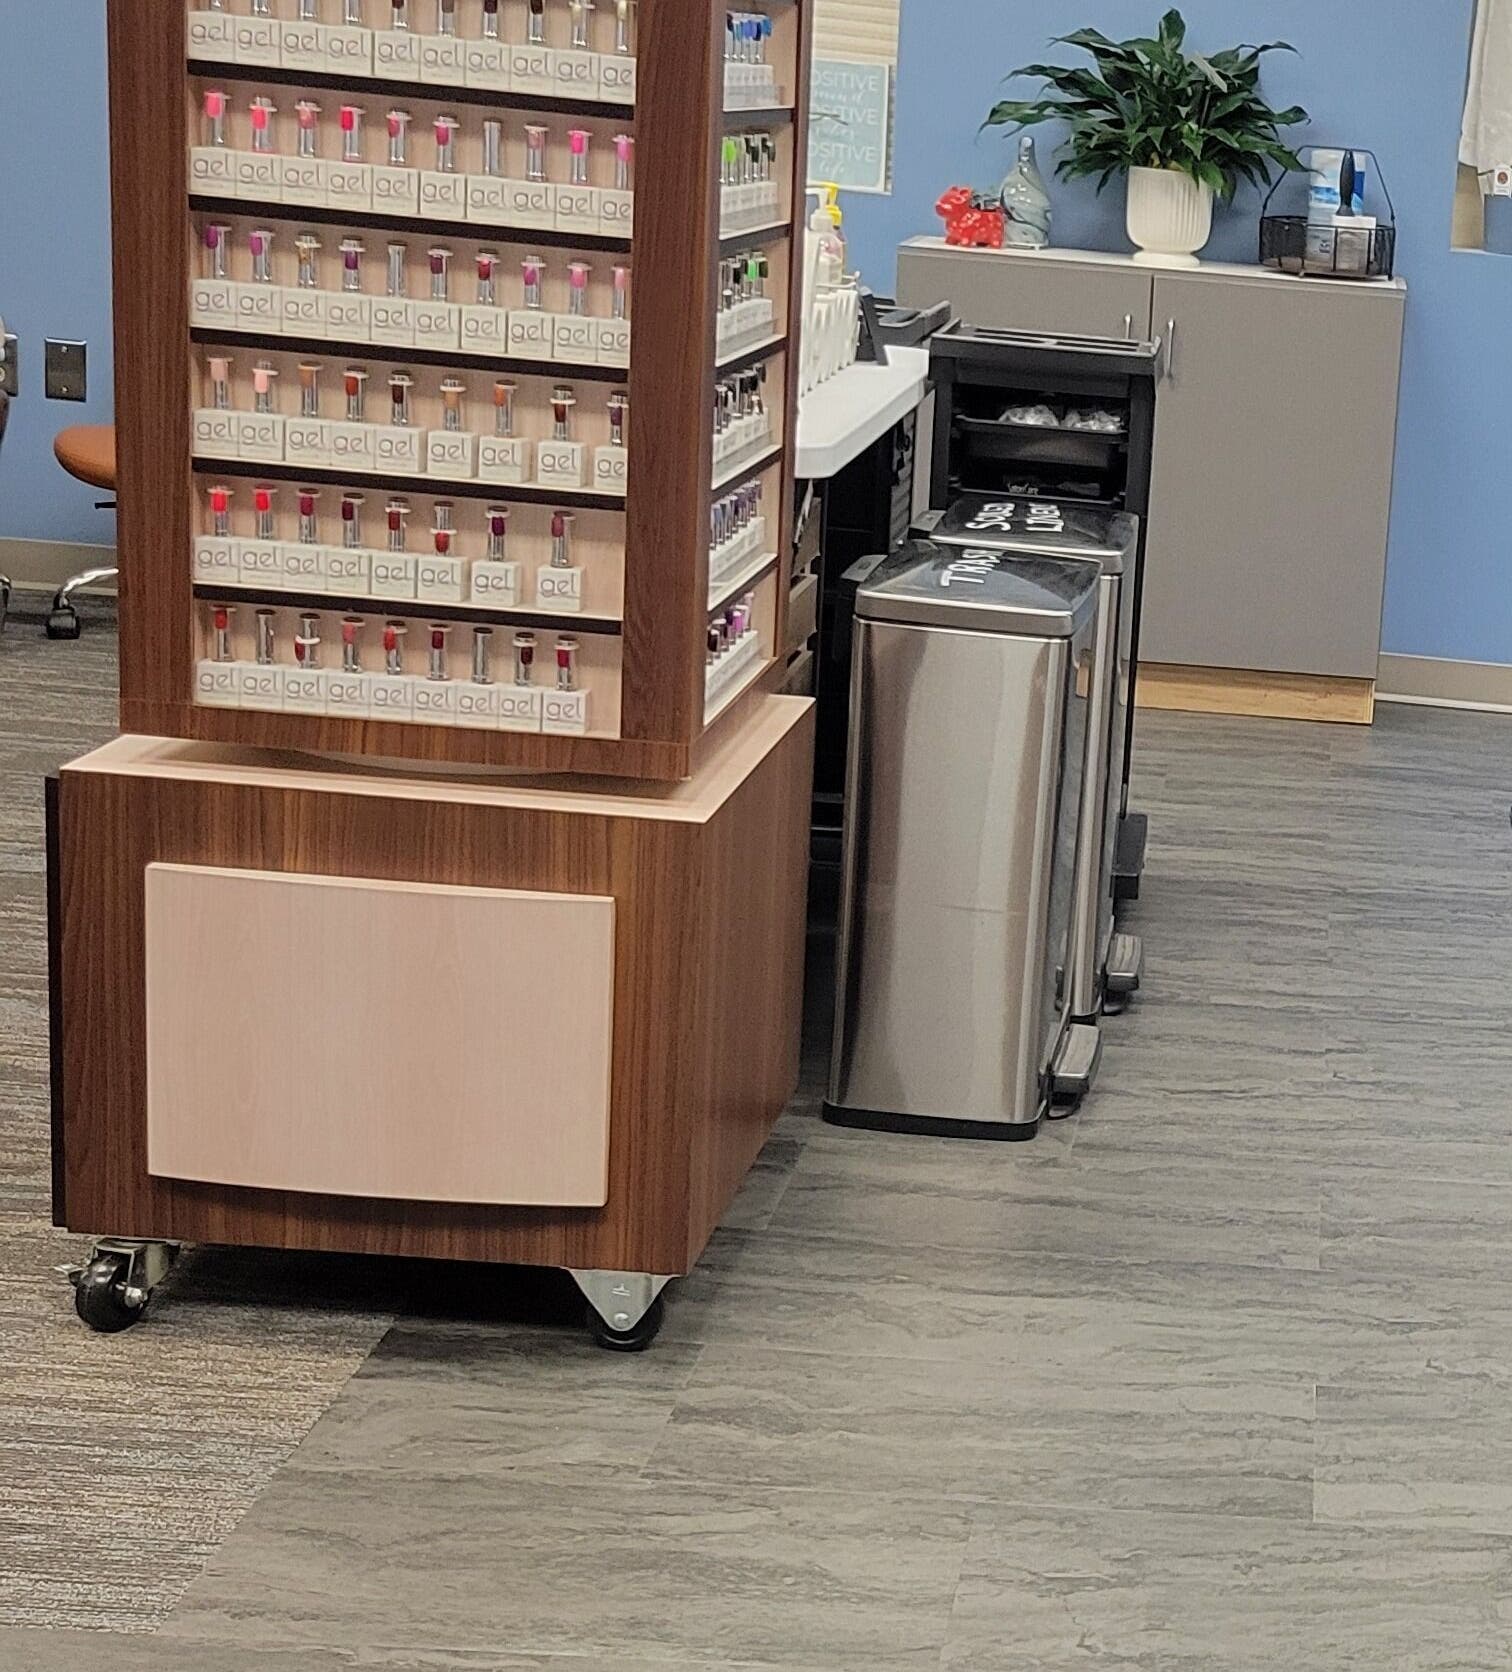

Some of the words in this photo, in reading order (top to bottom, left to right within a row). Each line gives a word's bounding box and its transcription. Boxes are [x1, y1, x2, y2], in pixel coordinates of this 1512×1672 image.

[191, 17, 228, 45] gel
[237, 22, 275, 50] gel
[283, 26, 321, 53] gel
[328, 31, 368, 59] gel
[377, 37, 418, 64] gel
[423, 41, 462, 68] gel
[468, 47, 506, 73] gel
[512, 51, 550, 78] gel
[557, 56, 594, 83] gel
[602, 66, 633, 88] ge
[193, 153, 231, 179] gel
[239, 157, 277, 185] gel
[284, 163, 321, 189] gel
[330, 168, 368, 194] gel
[375, 171, 413, 198] gel
[422, 177, 458, 203] gel
[469, 183, 506, 209] gel
[513, 185, 550, 213] gel
[558, 190, 594, 216] gel
[602, 199, 631, 221] ge
[195, 286, 232, 312] gel
[239, 291, 274, 317] gel
[284, 294, 320, 321] gel
[328, 300, 364, 326] gel
[374, 302, 410, 329] gel
[416, 307, 453, 334] gel
[464, 313, 500, 339] gel
[510, 317, 546, 344] gel
[556, 321, 593, 348] gel
[600, 330, 629, 351] ge
[196, 416, 233, 442] gel
[241, 419, 279, 446] gel
[288, 424, 325, 451] gel
[333, 430, 371, 456] gel
[378, 433, 415, 459] gel
[430, 437, 467, 463] gel
[481, 442, 517, 468] gel
[541, 447, 577, 474] gel
[597, 457, 625, 479] ge
[197, 545, 234, 570] gel
[242, 545, 280, 571] gel
[285, 551, 322, 577] gel
[328, 555, 364, 579] gel
[374, 558, 411, 584] gel
[420, 562, 457, 587] gel
[474, 568, 511, 594] gel
[540, 572, 577, 598] gel
[199, 667, 235, 693] gel
[242, 671, 279, 696] gel
[285, 676, 322, 700] gel
[329, 678, 365, 704] gel
[373, 681, 408, 707] gel
[415, 687, 451, 711] gel
[458, 690, 493, 715] gel
[500, 693, 536, 718] gel
[545, 696, 582, 721] gel
